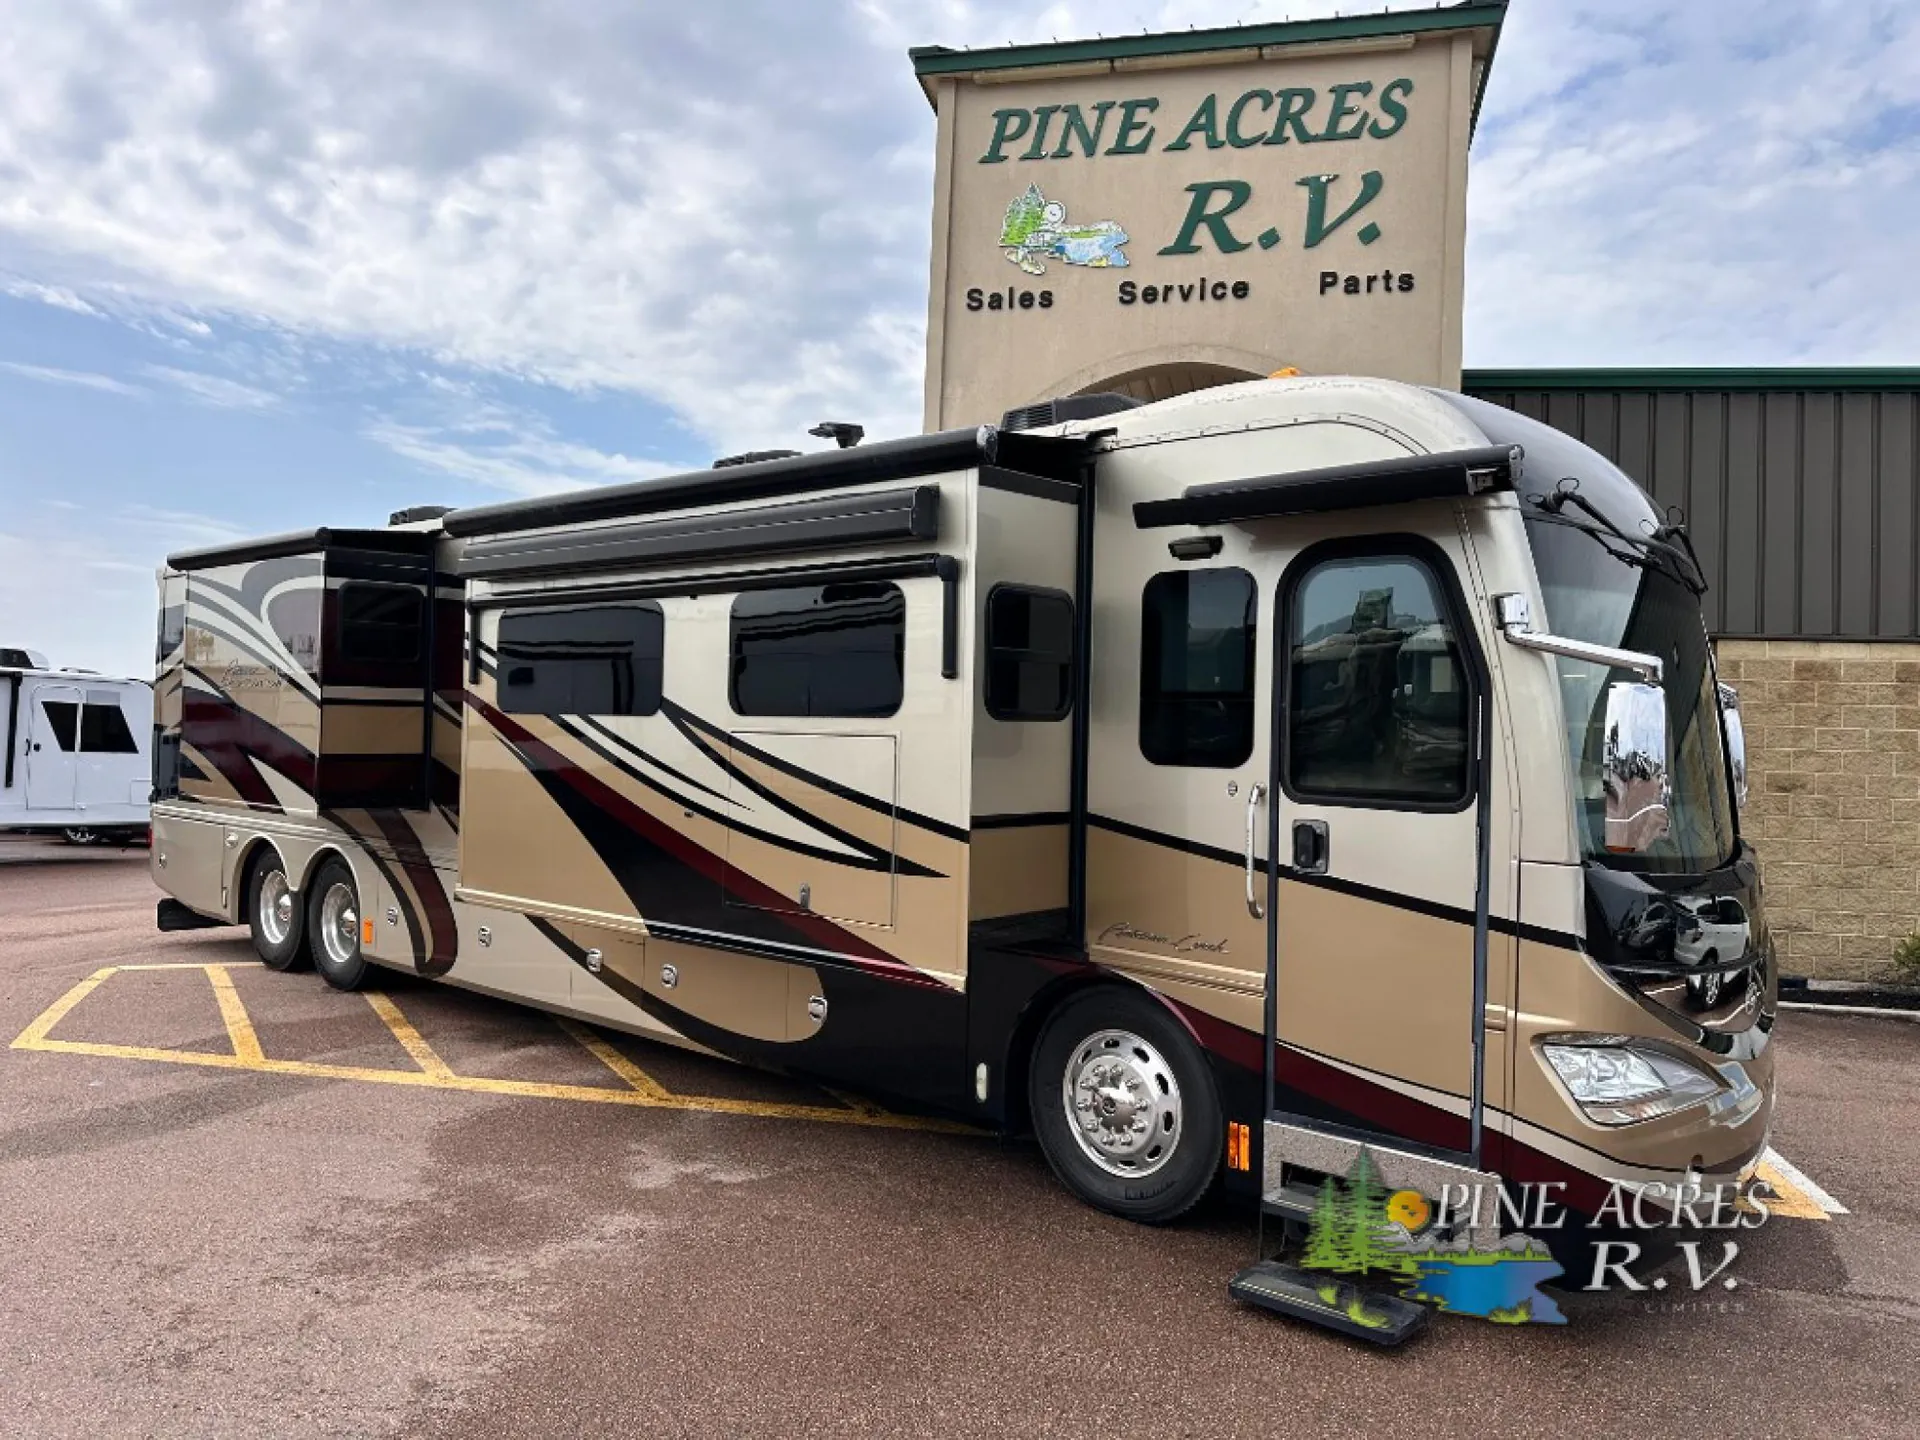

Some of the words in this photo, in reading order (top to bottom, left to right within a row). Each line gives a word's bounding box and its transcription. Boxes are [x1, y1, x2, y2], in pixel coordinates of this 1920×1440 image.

[978, 97, 1159, 164] PINE
[1163, 78, 1414, 153] ACRES
[1158, 170, 1383, 256] R.V.
[966, 287, 1055, 312] Sales
[1118, 277, 1250, 305] Service
[1319, 269, 1415, 296] Parts
